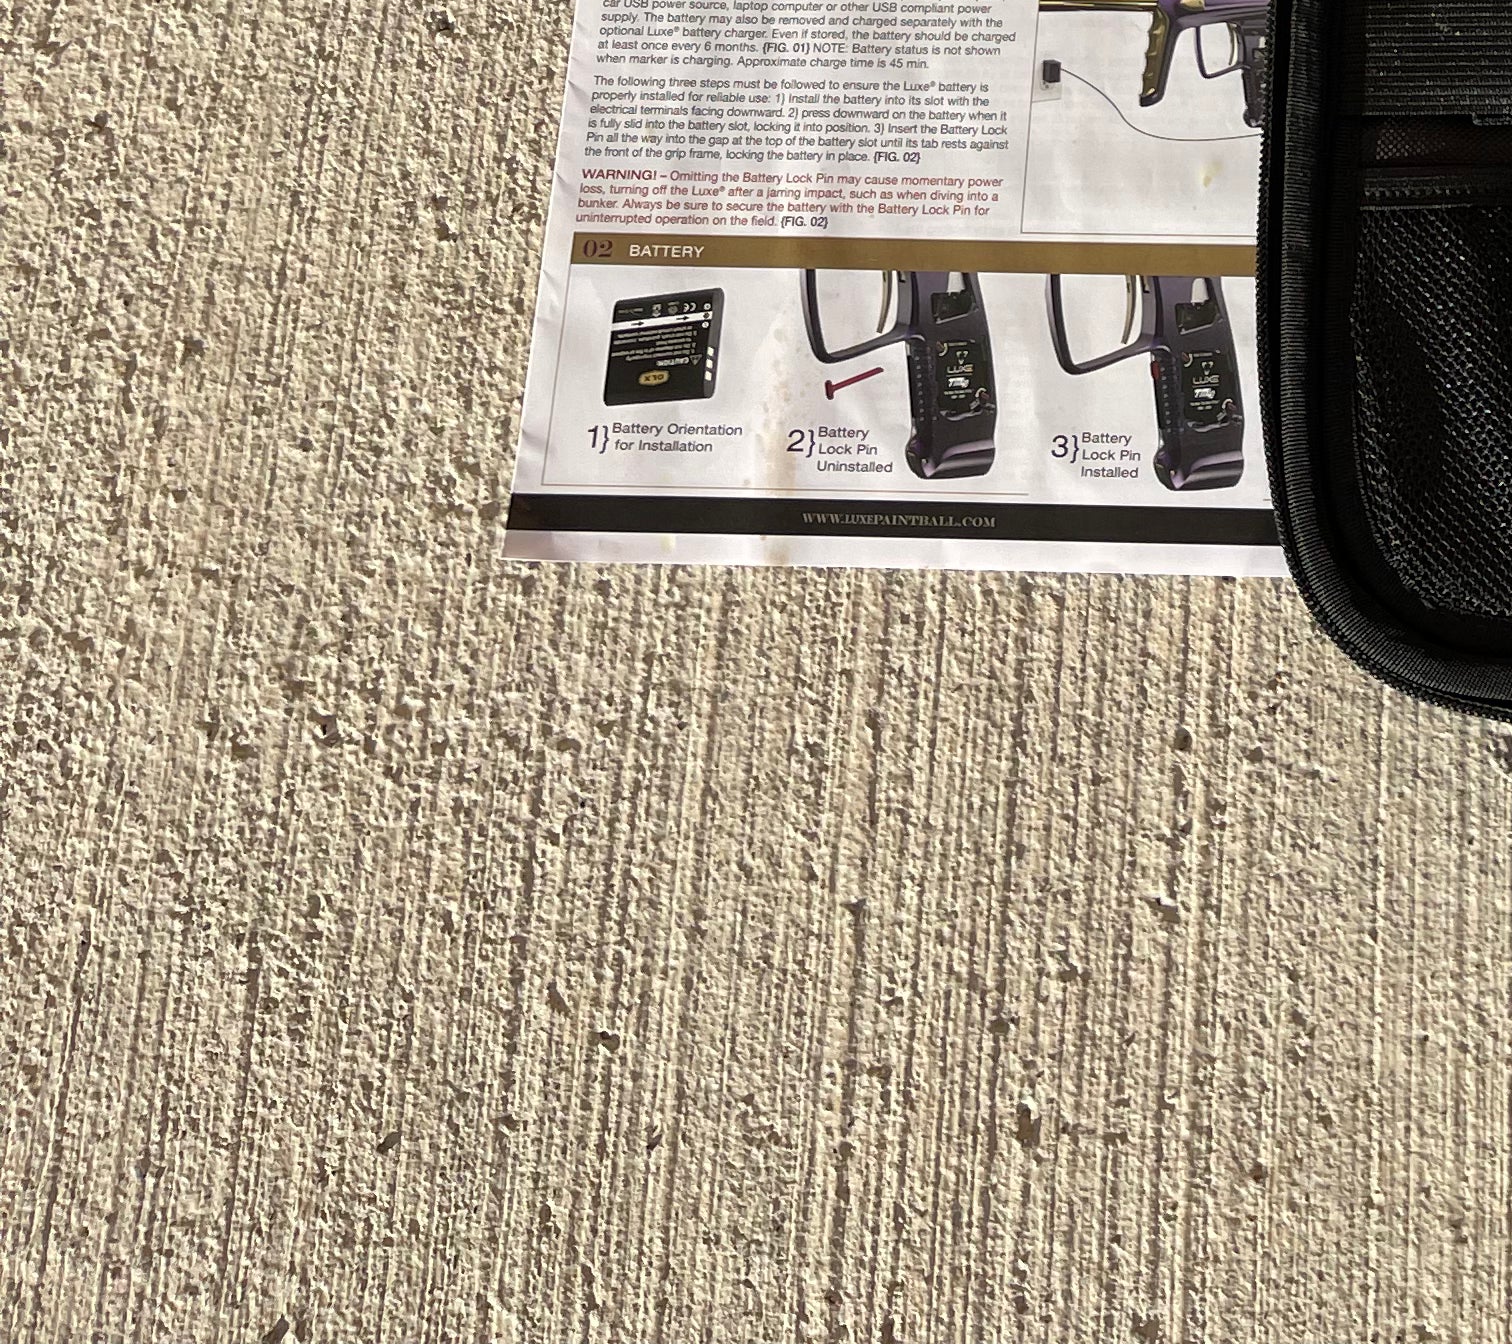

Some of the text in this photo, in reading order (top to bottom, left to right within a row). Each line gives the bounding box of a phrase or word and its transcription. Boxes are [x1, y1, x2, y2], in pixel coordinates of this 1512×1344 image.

[583, 239, 705, 258] 02 BATTERY
[612, 422, 743, 438] Battery Orientation
[818, 426, 870, 442] Battery
[615, 439, 713, 452] for Installation
[1081, 431, 1132, 447] Battery
[818, 443, 878, 456] Lock Pin
[1079, 447, 1141, 461] Lock Pin
[817, 460, 893, 473] Uninstalled
[1081, 466, 1139, 479] Installed
[802, 513, 995, 528] WWW.LUXEPAINTBALL.COM
